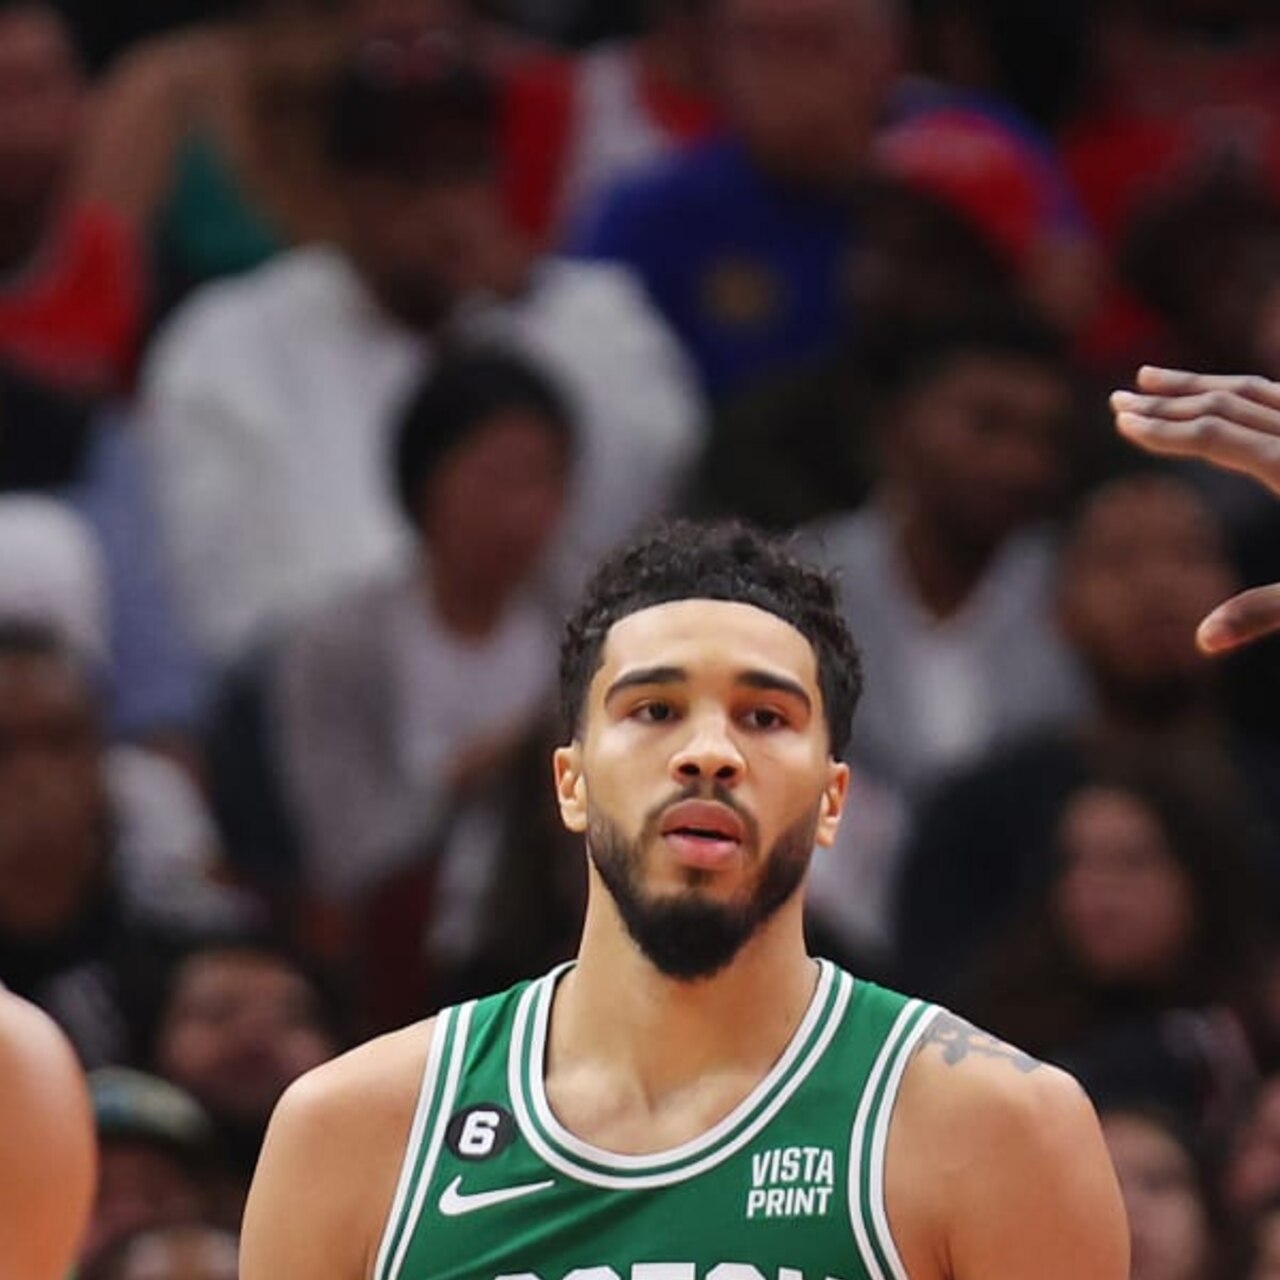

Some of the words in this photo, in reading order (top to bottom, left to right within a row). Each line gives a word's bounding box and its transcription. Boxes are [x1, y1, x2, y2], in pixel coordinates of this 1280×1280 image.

[458, 1110, 500, 1156] 6
[751, 1146, 835, 1187] VISTA
[746, 1186, 834, 1219] PRINT
